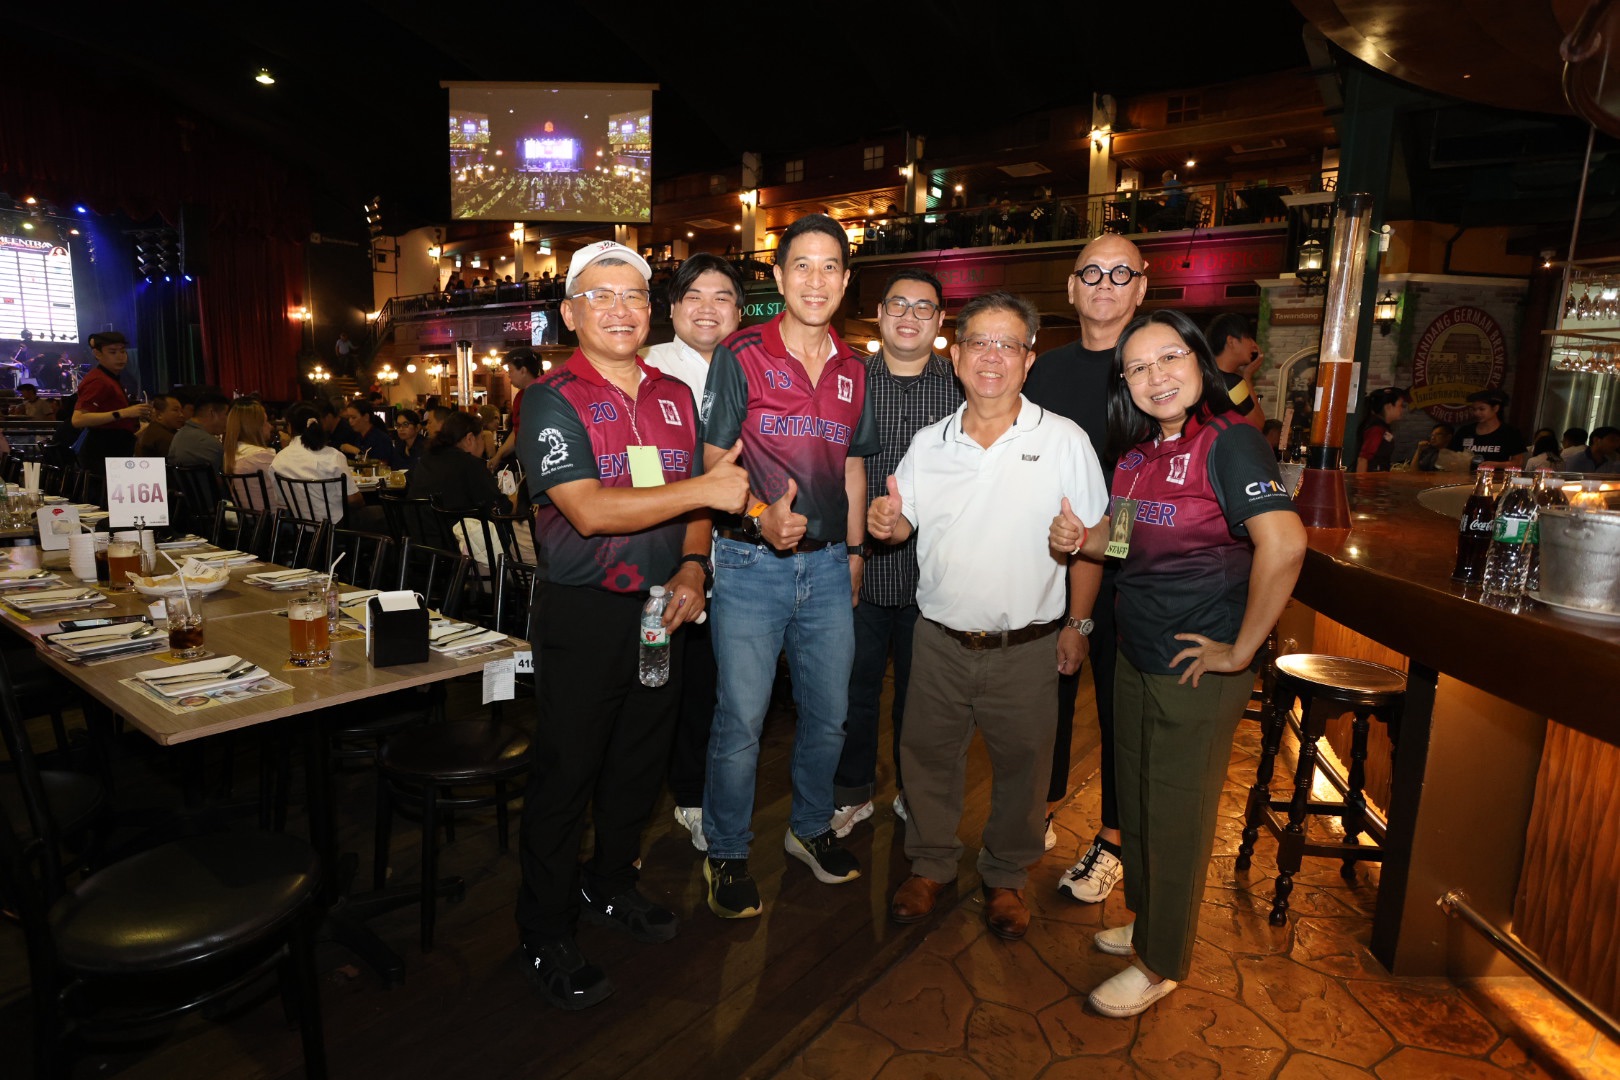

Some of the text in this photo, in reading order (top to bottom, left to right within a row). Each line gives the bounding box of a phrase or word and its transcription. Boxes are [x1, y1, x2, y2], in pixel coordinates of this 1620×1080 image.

[1274, 312, 1319, 321] Tawandang
[1414, 314, 1452, 386] TAWANDANG
[1453, 307, 1495, 334] GERMAN
[765, 369, 792, 390] 13
[588, 402, 618, 424] 20
[1430, 406, 1454, 423] SINCE
[111, 483, 164, 503] 416A
[1245, 480, 1287, 496] CMU
[1107, 544, 1128, 555] STAFF
